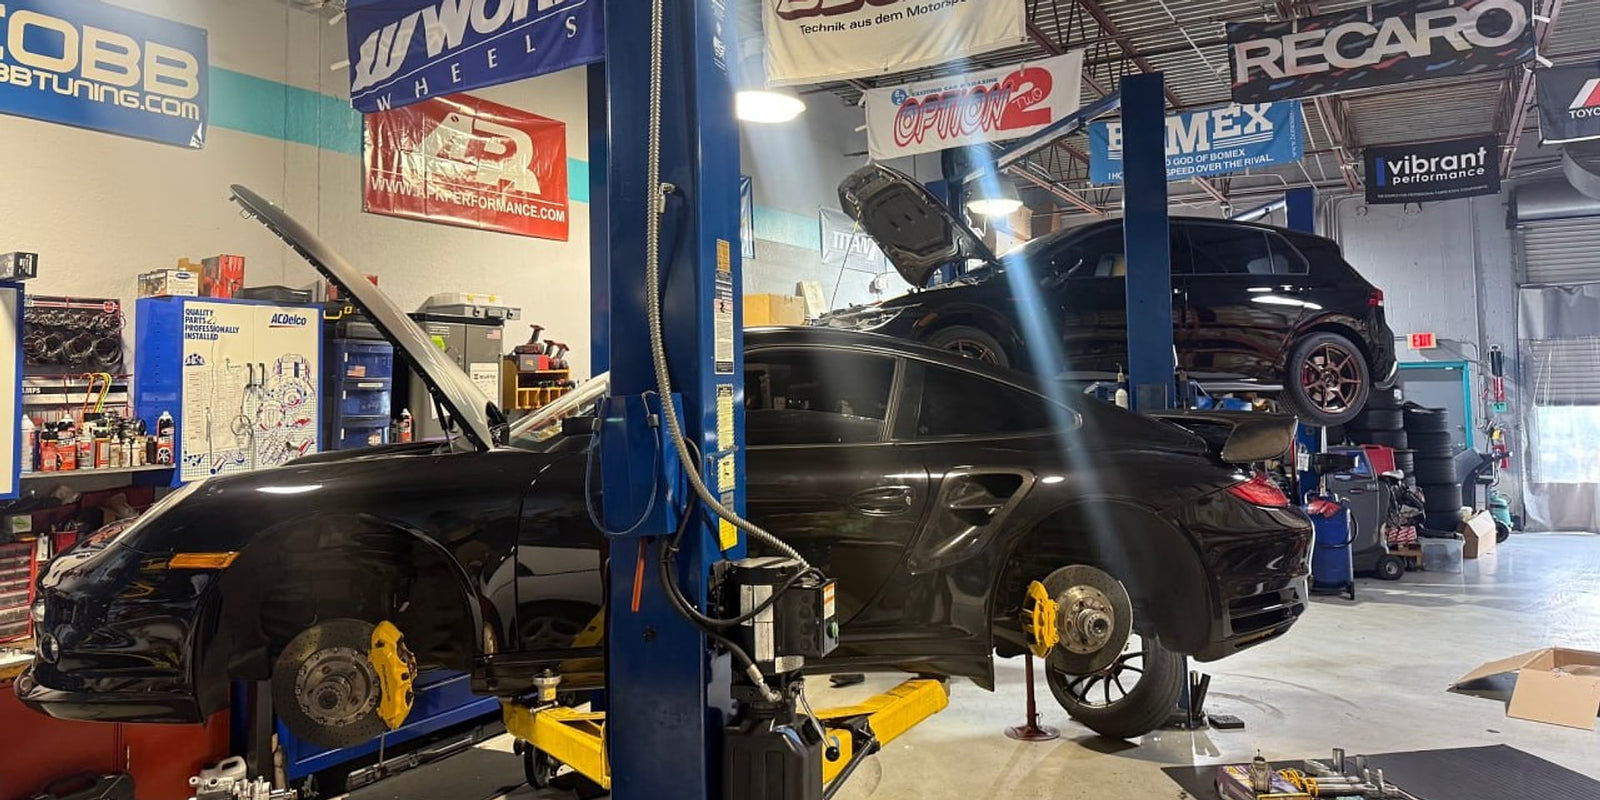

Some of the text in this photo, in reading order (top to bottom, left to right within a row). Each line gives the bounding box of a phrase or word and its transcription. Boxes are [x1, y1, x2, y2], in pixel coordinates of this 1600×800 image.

[800, 22, 846, 35] Technik
[849, 18, 872, 29] aus
[875, 12, 903, 24] dem
[906, 0, 966, 17] Motorsp
[1234, 0, 1527, 83] RECARO
[0, 4, 199, 100] OBB
[894, 67, 1053, 147] OPTION 2
[1172, 149, 1246, 165] GOD OF BOMEX
[1387, 146, 1487, 175] vibrant
[1166, 166, 1195, 176] SPEED
[1195, 162, 1221, 173] OVER
[1222, 159, 1243, 169] THE
[1392, 166, 1485, 185] performance
[185, 308, 214, 316] QUALITY
[185, 316, 206, 324] PARTS
[271, 313, 307, 325] ACDelco
[185, 325, 239, 334] PROFESSIONALLY
[185, 333, 219, 341] INSTALLED
